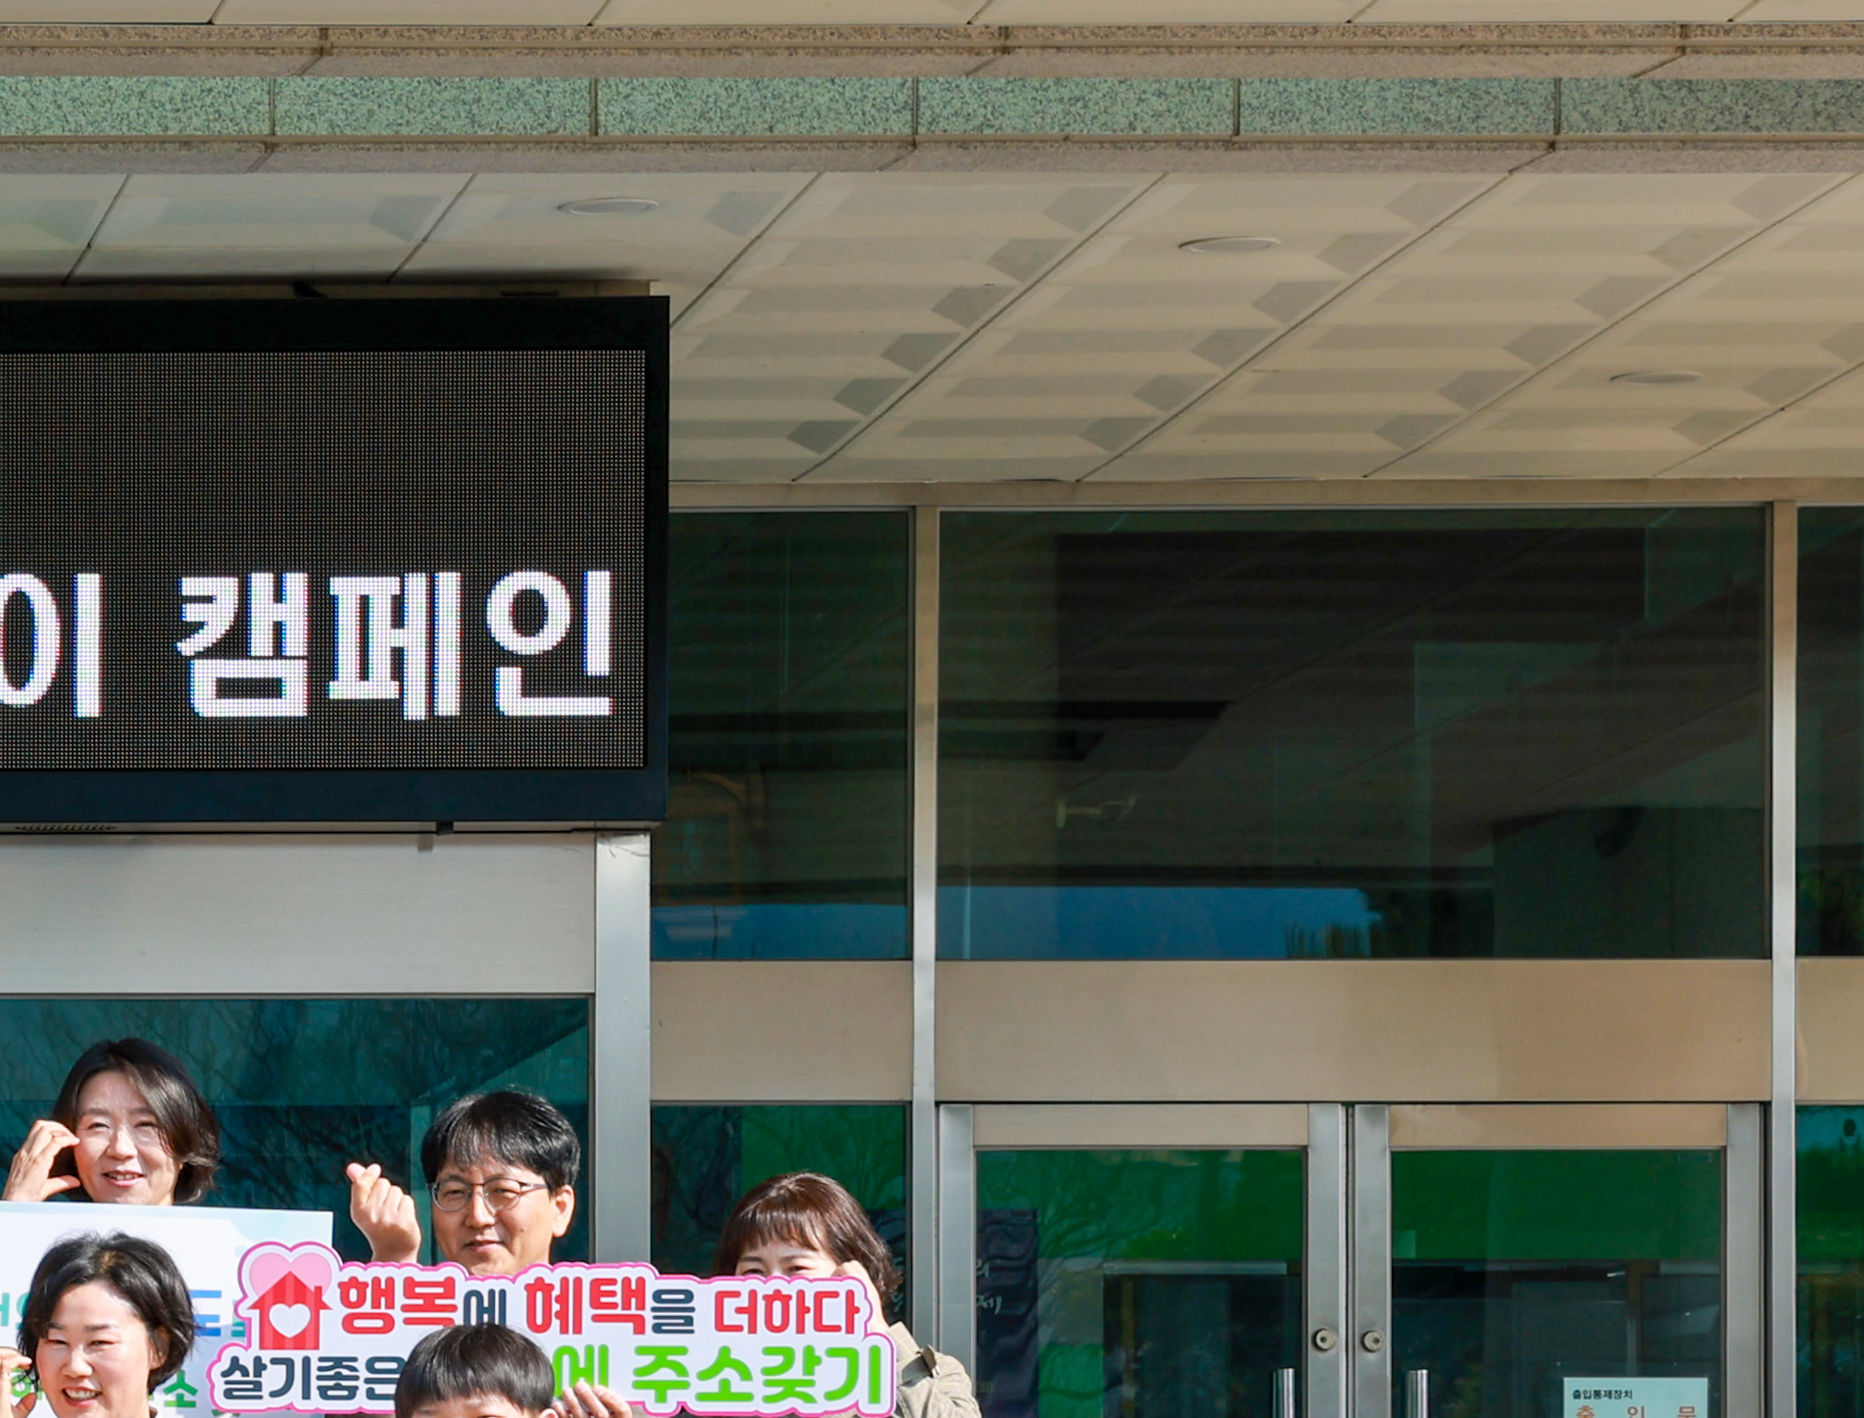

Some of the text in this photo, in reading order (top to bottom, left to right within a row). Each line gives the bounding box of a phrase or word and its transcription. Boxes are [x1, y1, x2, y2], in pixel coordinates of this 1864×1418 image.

[175, 569, 614, 722] 캠페인
[336, 1274, 508, 1336] 행복에
[523, 1274, 697, 1336] 혜택을
[713, 1278, 863, 1336] 더하다
[219, 1354, 407, 1403] 살기좋은
[631, 1344, 883, 1406] 주소갖기
